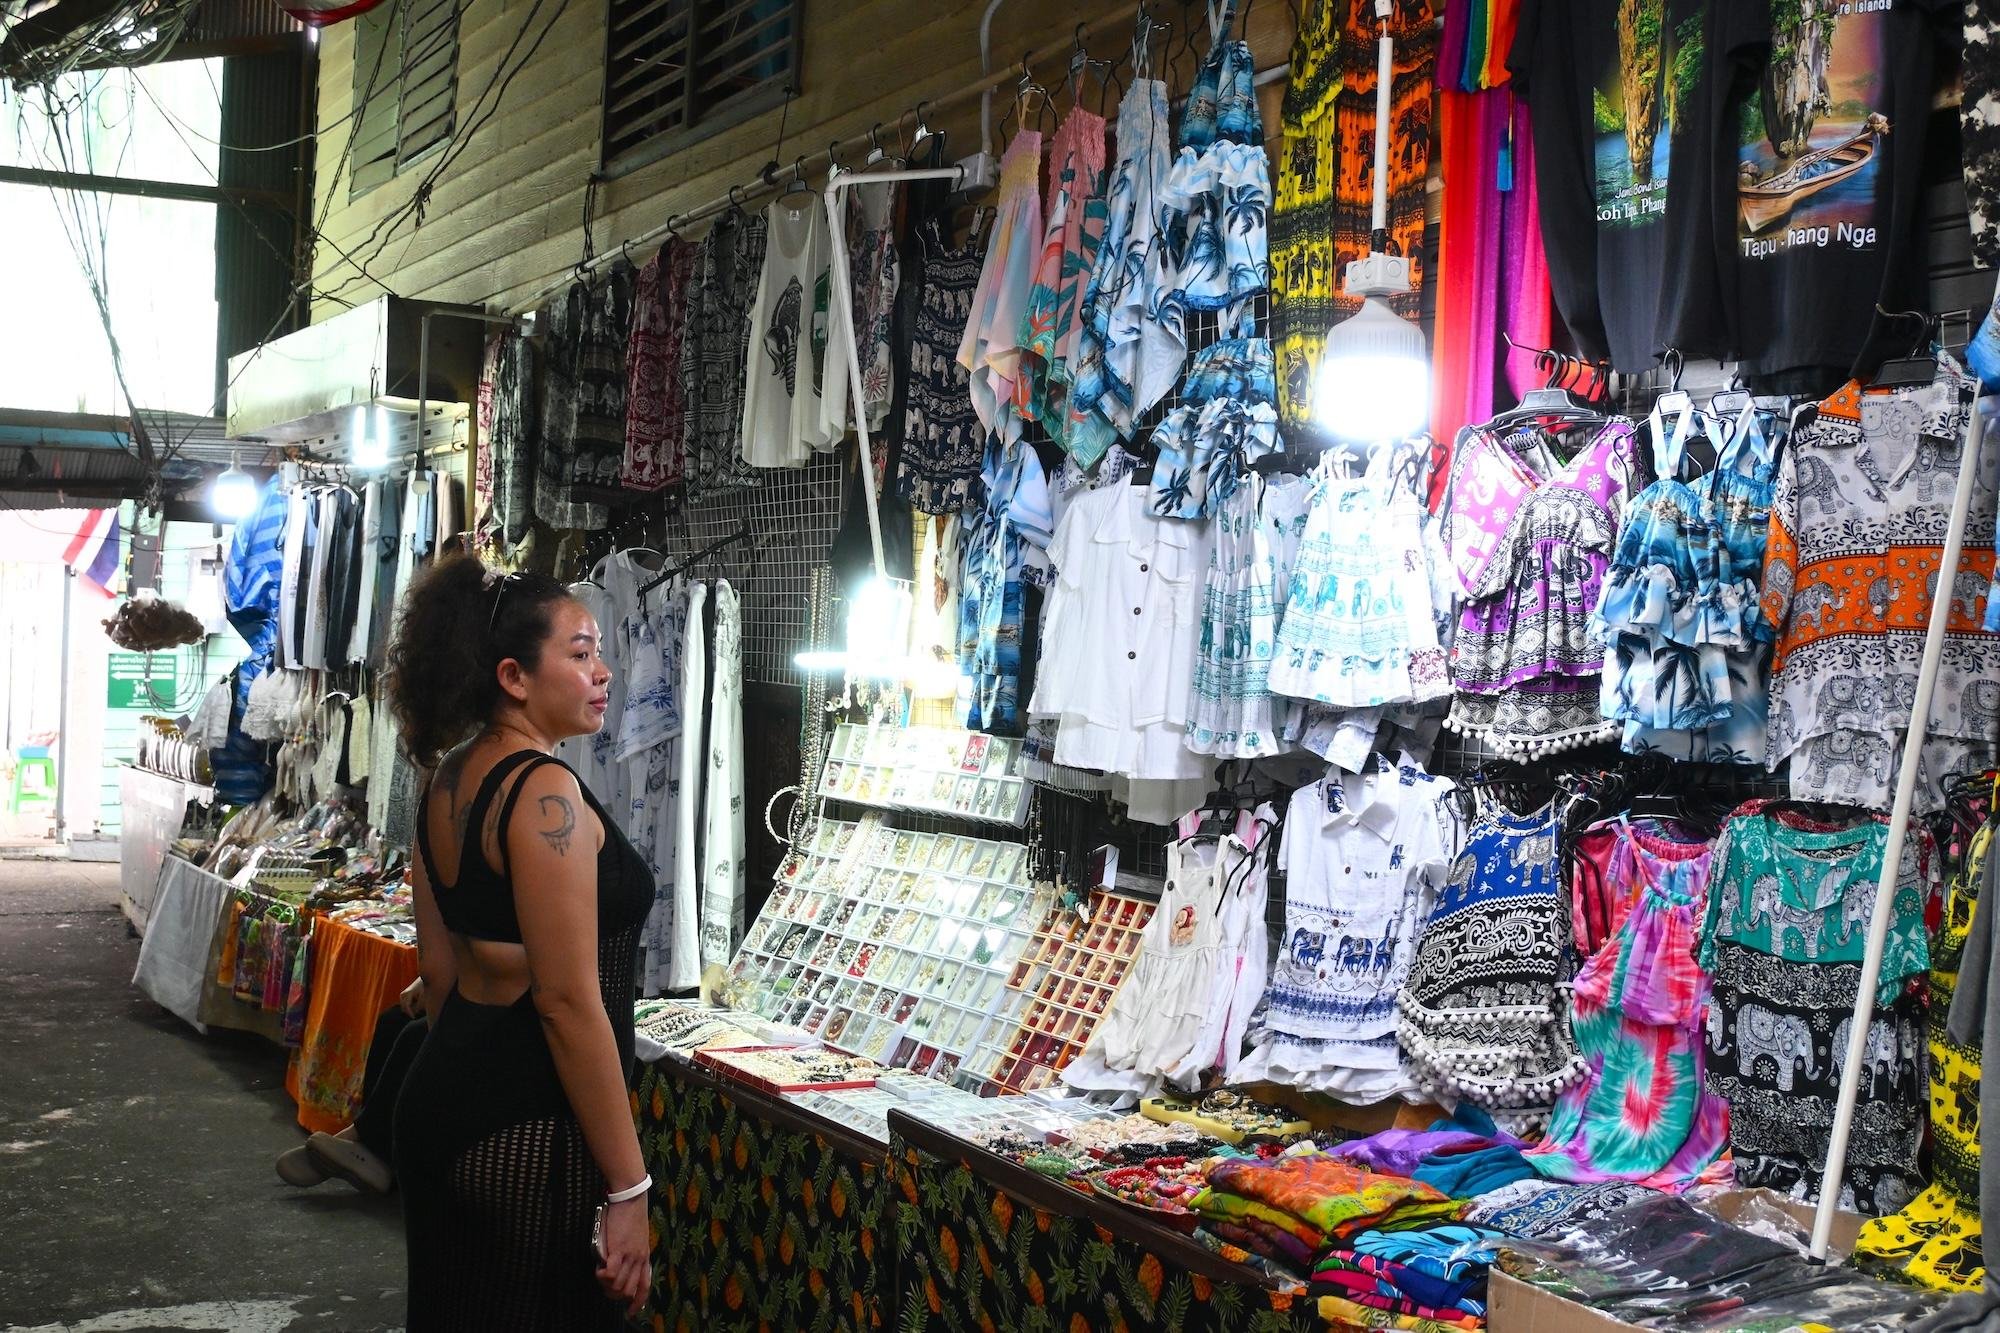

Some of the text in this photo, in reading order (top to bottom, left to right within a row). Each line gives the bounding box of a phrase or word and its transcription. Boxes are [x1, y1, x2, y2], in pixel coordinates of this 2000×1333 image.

[1854, 0, 1892, 13] Islands
[1741, 222, 1877, 260] Tapu hang Nga
